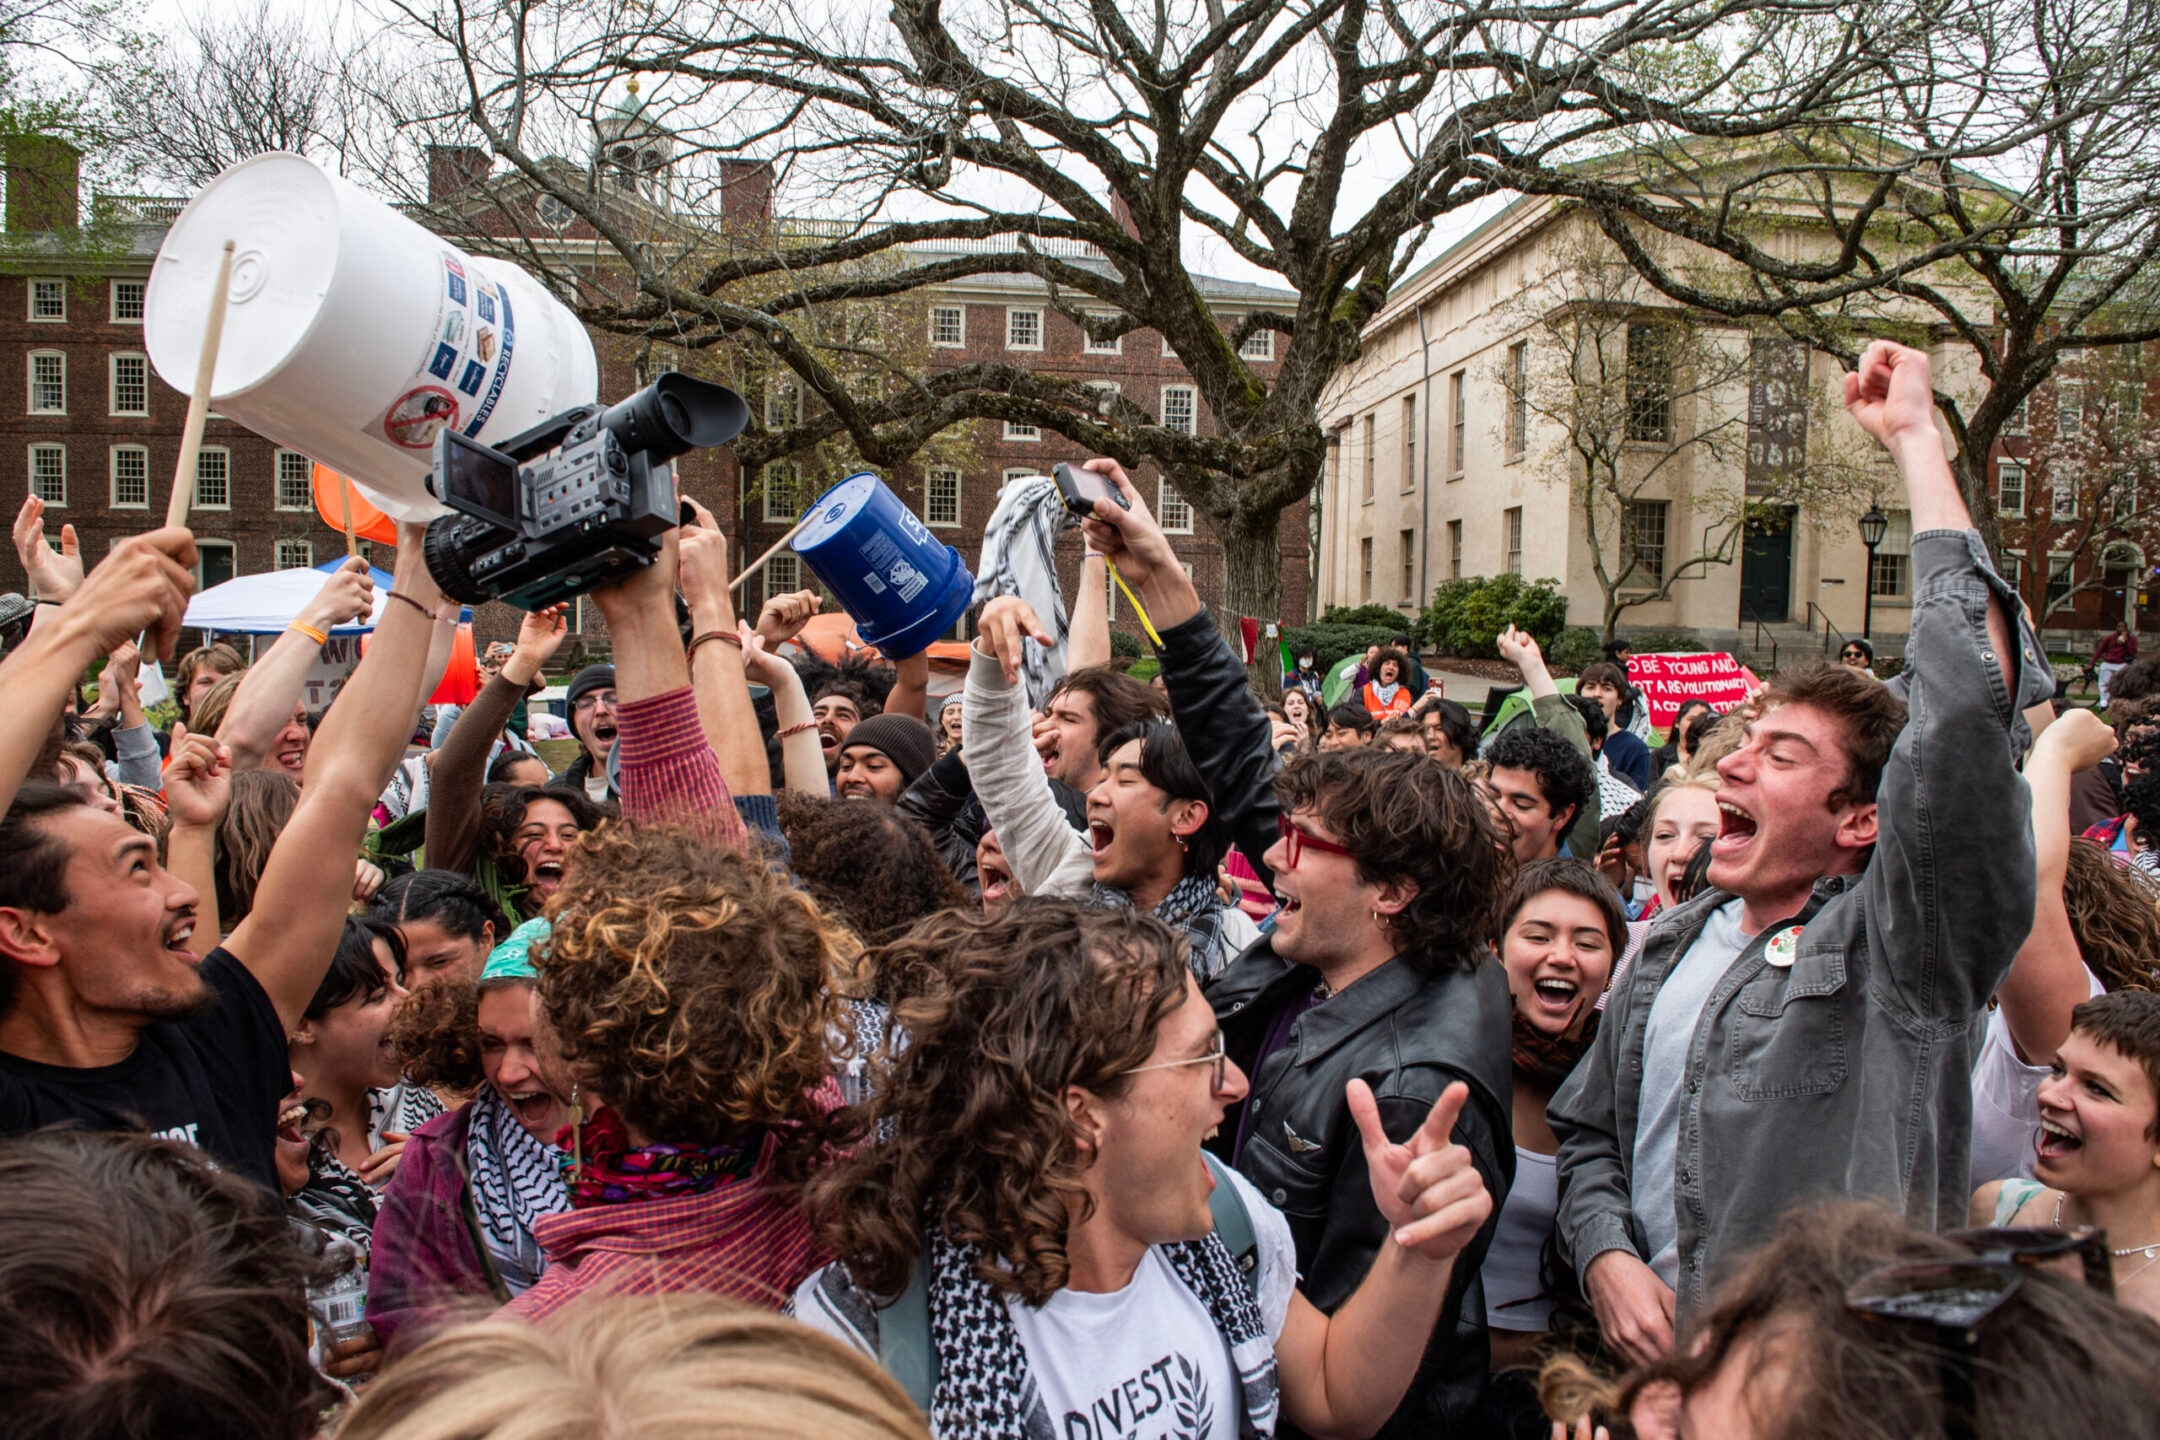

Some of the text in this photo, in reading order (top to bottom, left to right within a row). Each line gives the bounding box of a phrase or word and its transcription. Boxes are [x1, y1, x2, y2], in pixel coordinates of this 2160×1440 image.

[476, 348, 512, 423] RECYCLABLES
[1641, 659, 1662, 674] BE
[1663, 660, 1710, 676] YOUNG
[1711, 657, 1739, 674] AND
[1656, 679, 1668, 694] A
[1666, 677, 1746, 695] REVOLUTIONARY
[1652, 699, 1663, 712] A
[1065, 1355, 1177, 1440] DIVEST
